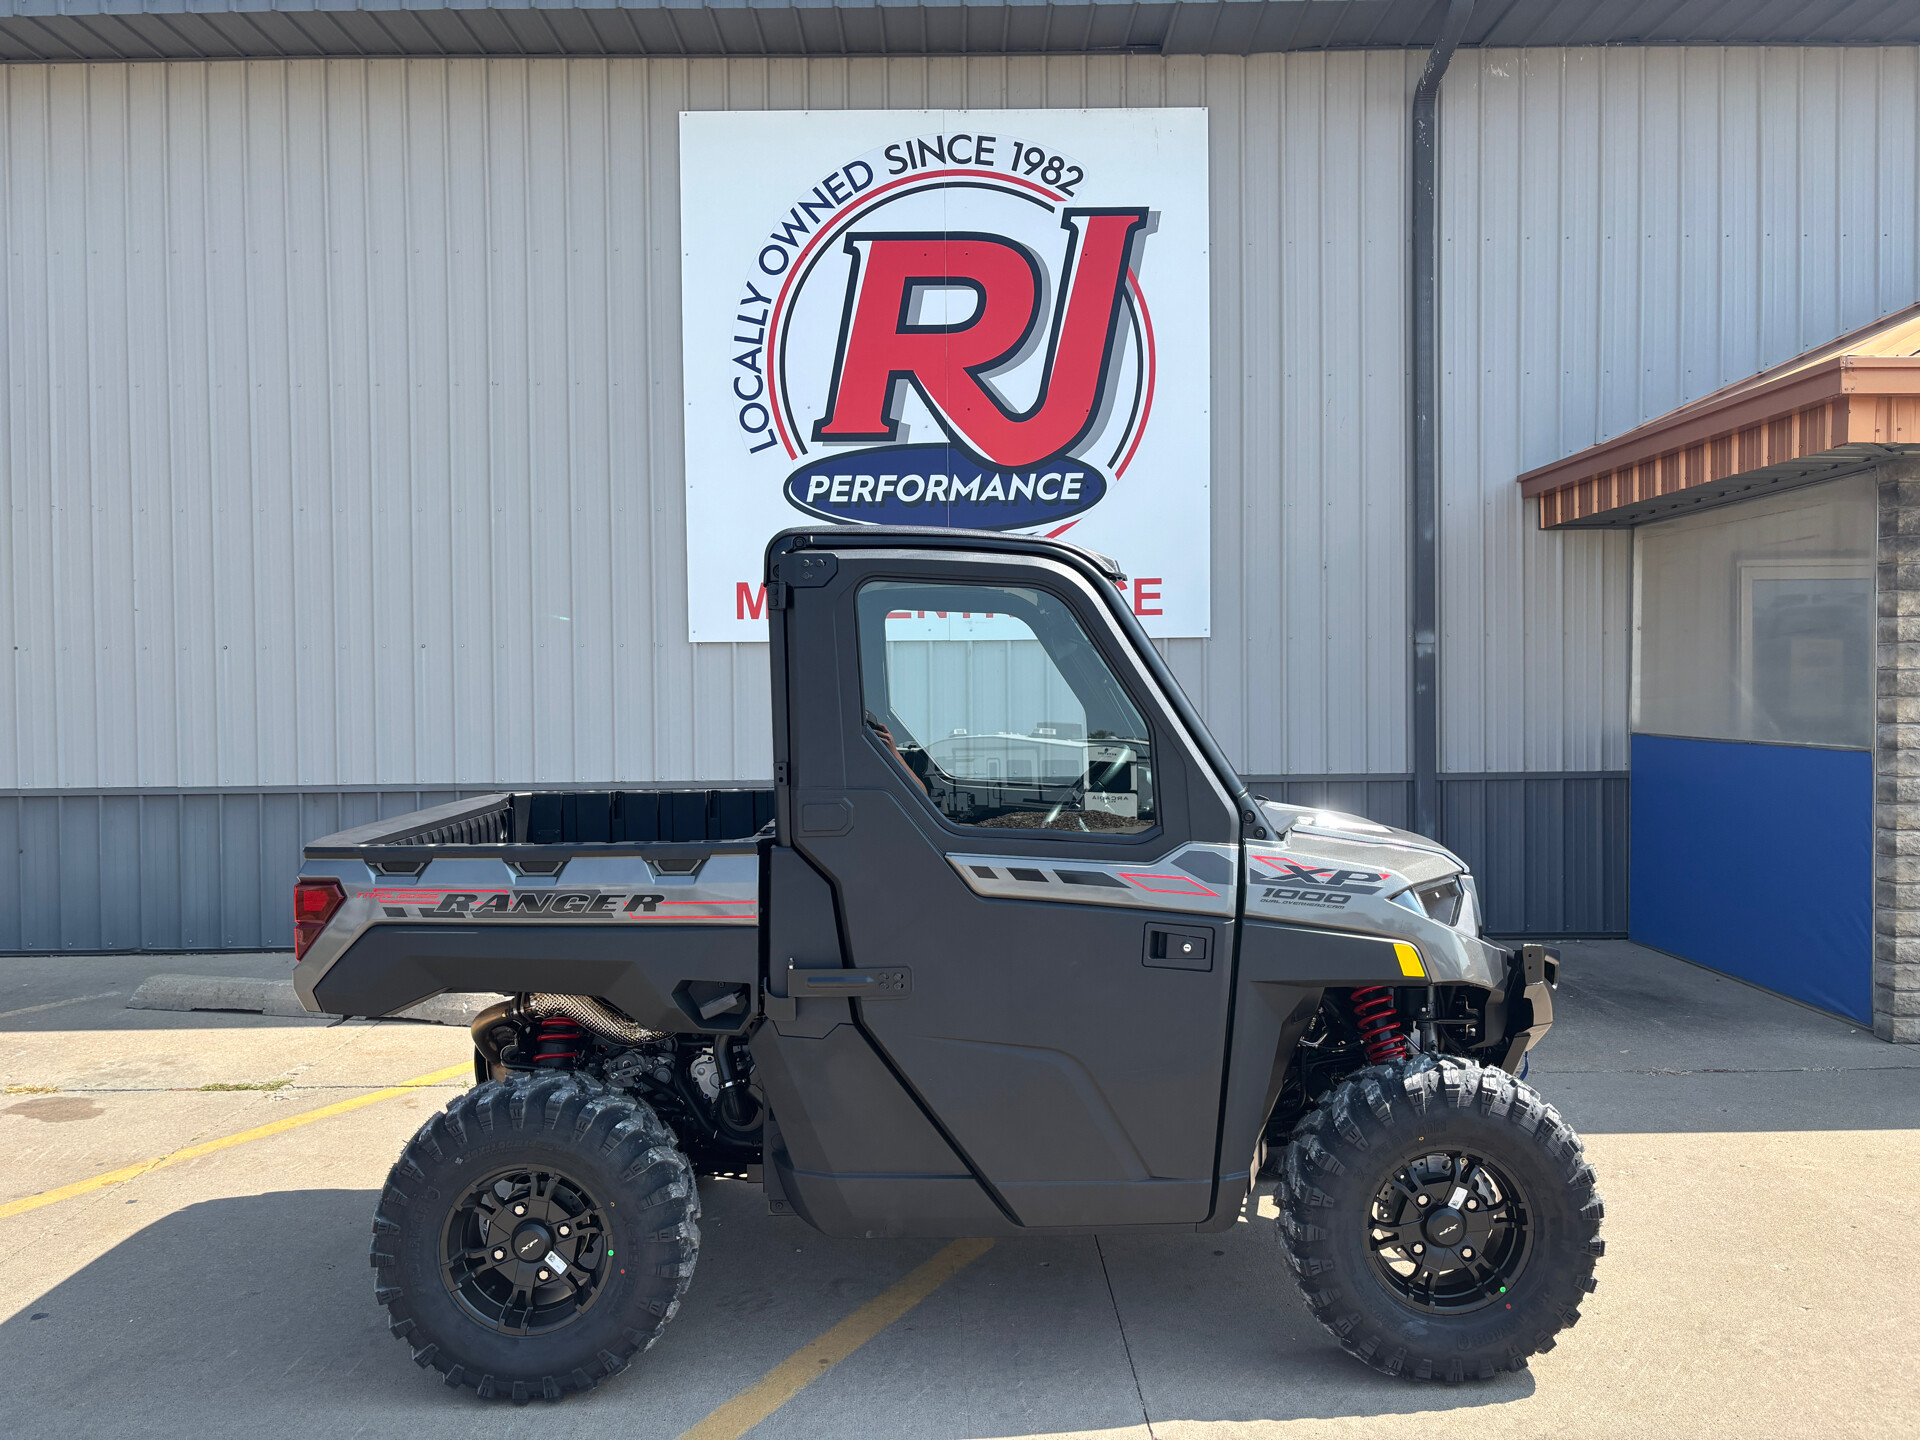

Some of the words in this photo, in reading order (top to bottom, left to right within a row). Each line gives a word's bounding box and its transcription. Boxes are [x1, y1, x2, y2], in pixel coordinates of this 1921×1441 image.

[732, 281, 777, 454] LOCALLY
[758, 160, 874, 275] OWNED
[884, 134, 996, 174] SINCE
[1011, 141, 1084, 197] 1982
[811, 207, 1150, 468] RJ
[806, 472, 1084, 503] PERFORMANCE
[1269, 865, 1383, 886] XP
[434, 893, 665, 913] RANGER
[1263, 887, 1352, 904] 1000
[1282, 900, 1326, 908] OVERHEAD
